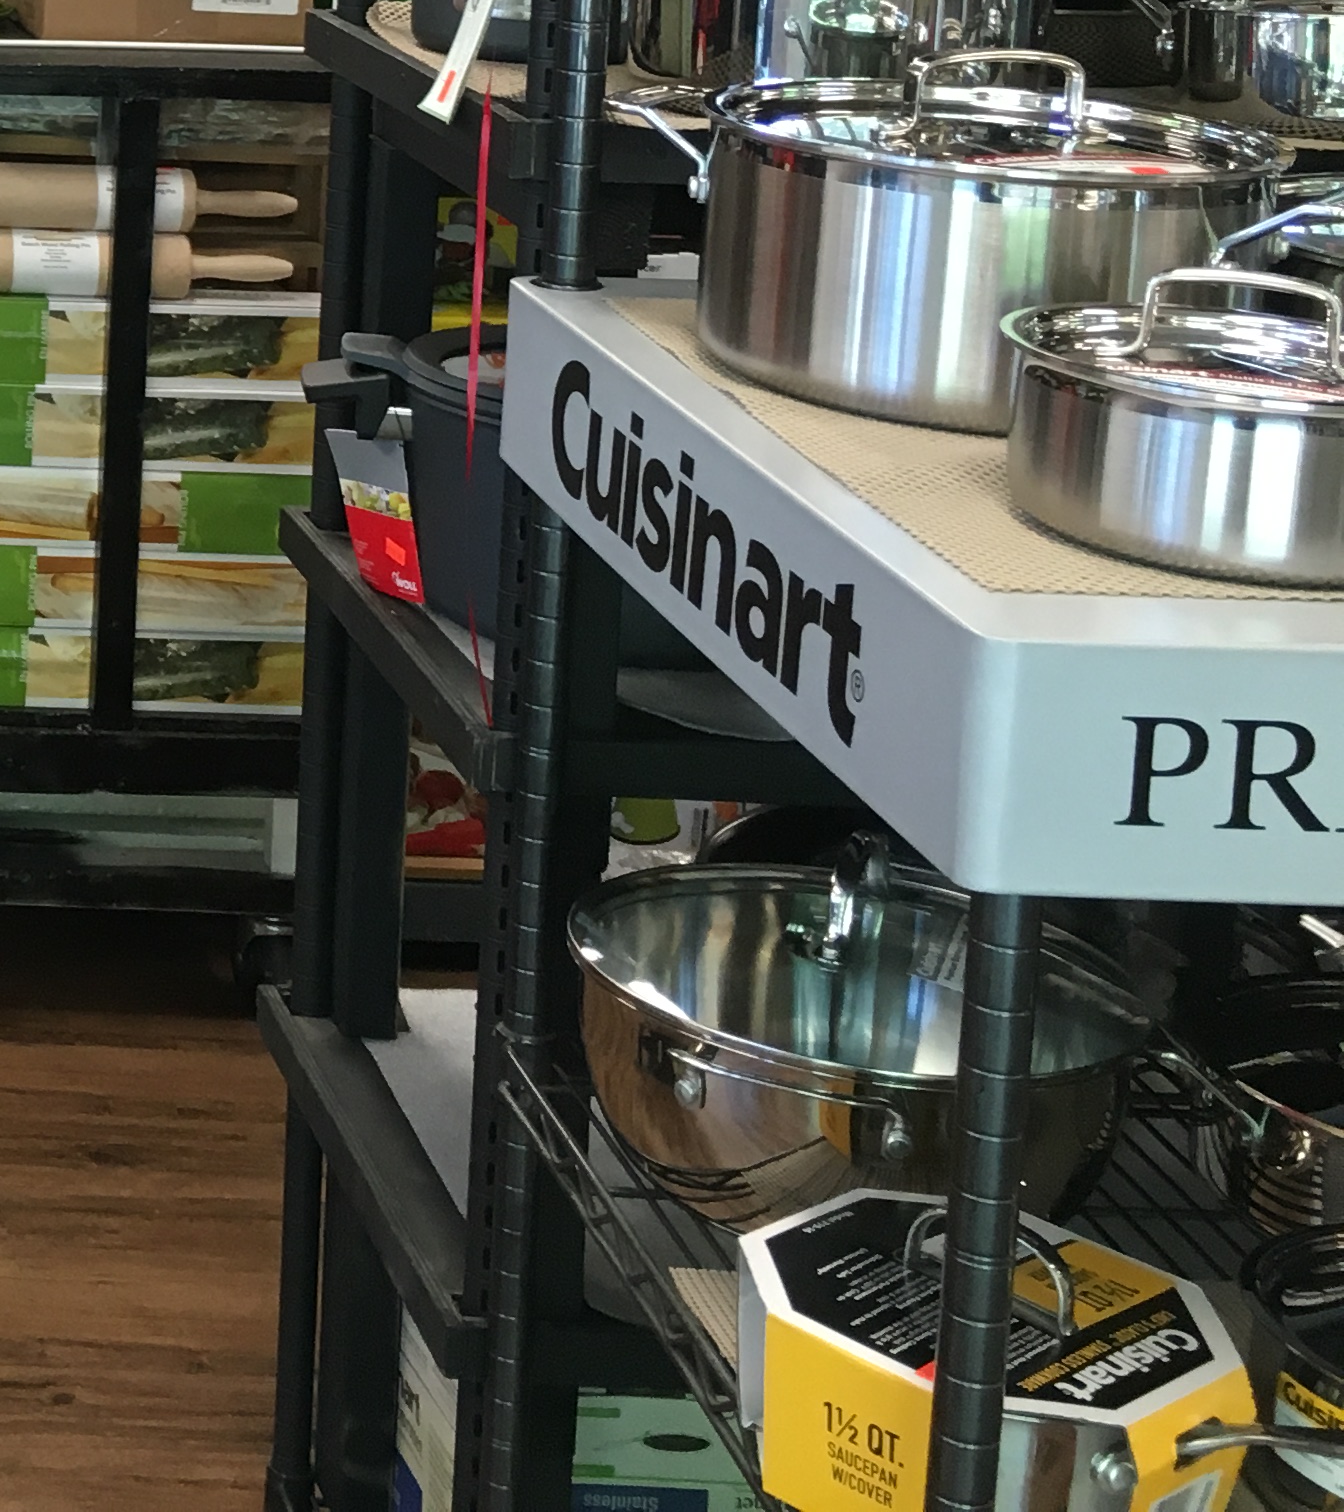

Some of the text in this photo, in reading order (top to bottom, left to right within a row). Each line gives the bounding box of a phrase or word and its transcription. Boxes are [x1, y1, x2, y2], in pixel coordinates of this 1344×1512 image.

[551, 359, 863, 748] Cuisinart
[1113, 716, 1344, 833] PR
[1054, 1328, 1200, 1402] Cuisinart
[826, 1441, 898, 1490] SAUCEPAN
[867, 1422, 905, 1469] QT.
[830, 1463, 893, 1509] W/COVER
